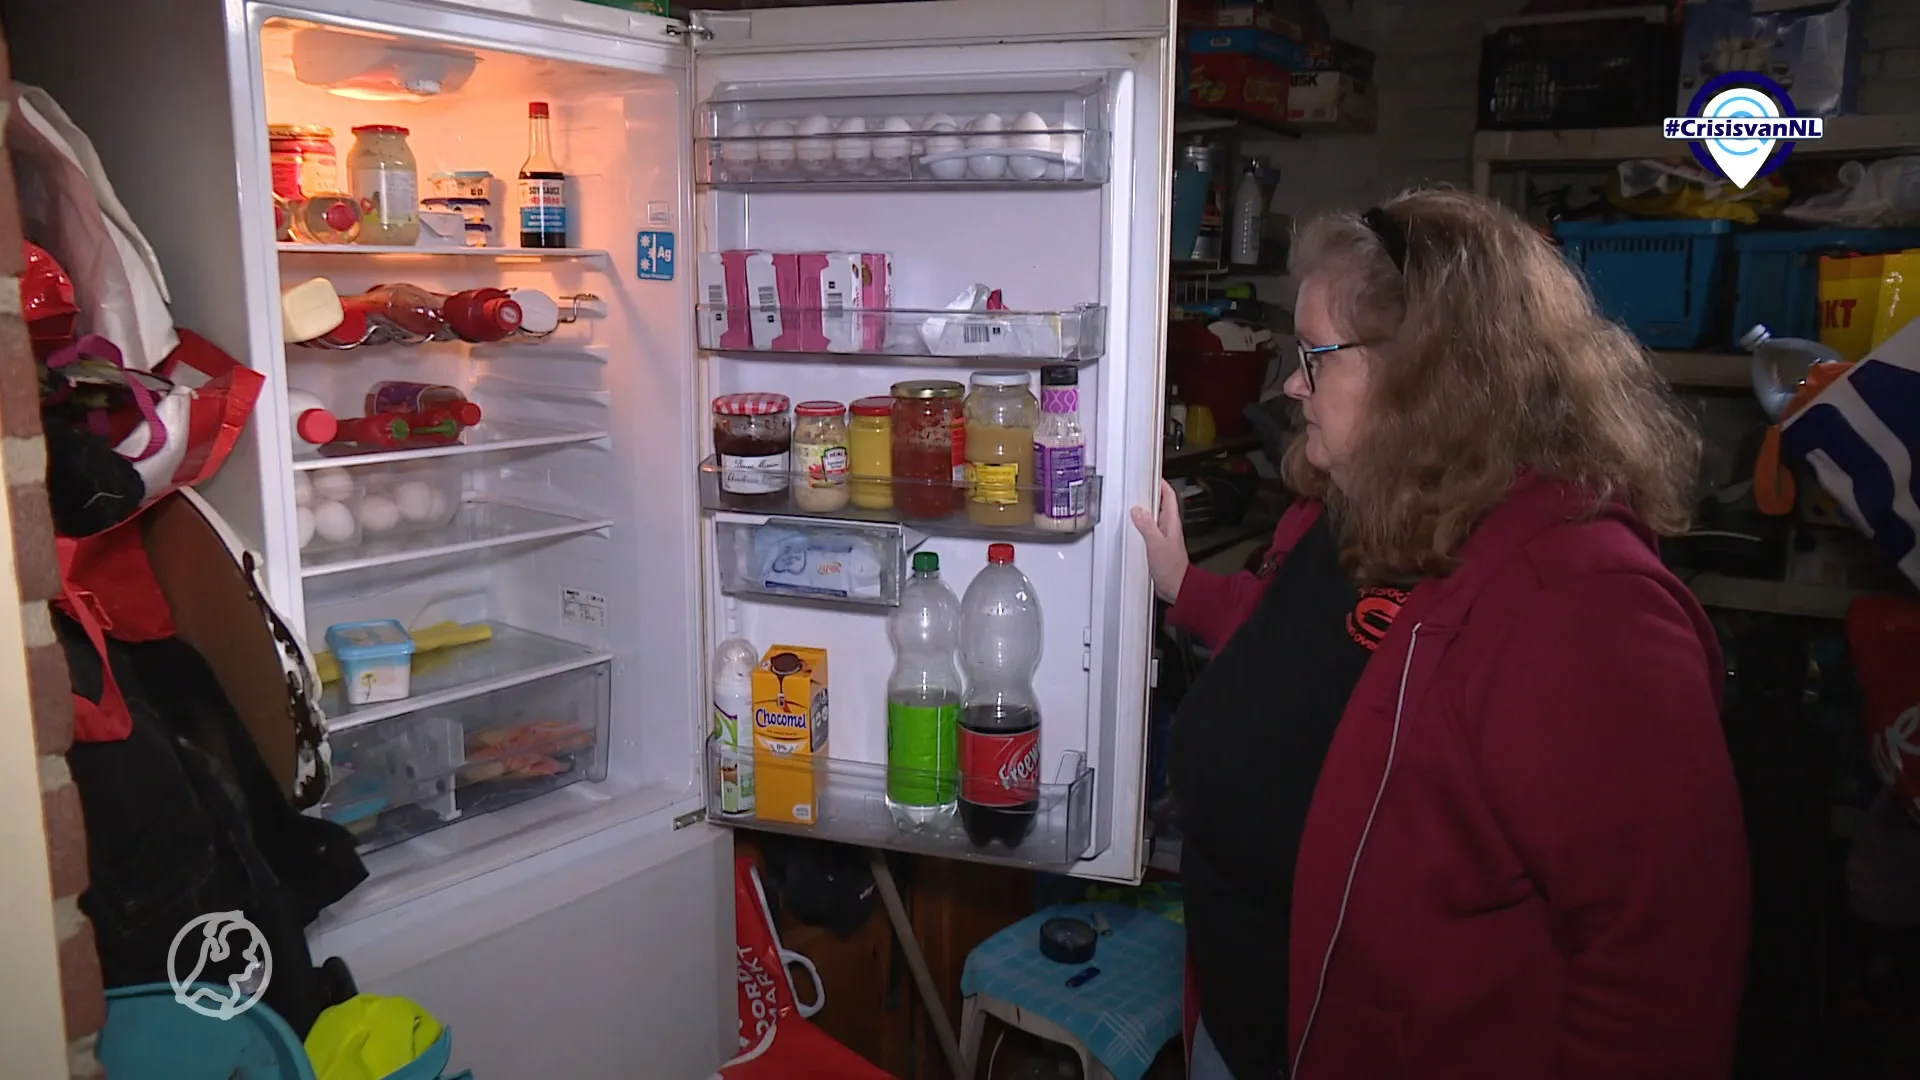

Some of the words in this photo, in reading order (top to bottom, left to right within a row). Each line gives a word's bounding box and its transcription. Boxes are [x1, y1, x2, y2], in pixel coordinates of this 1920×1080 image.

[1290, 74, 1319, 88] ISK
[657, 245, 672, 262] Ag
[755, 708, 807, 729] Chocomel
